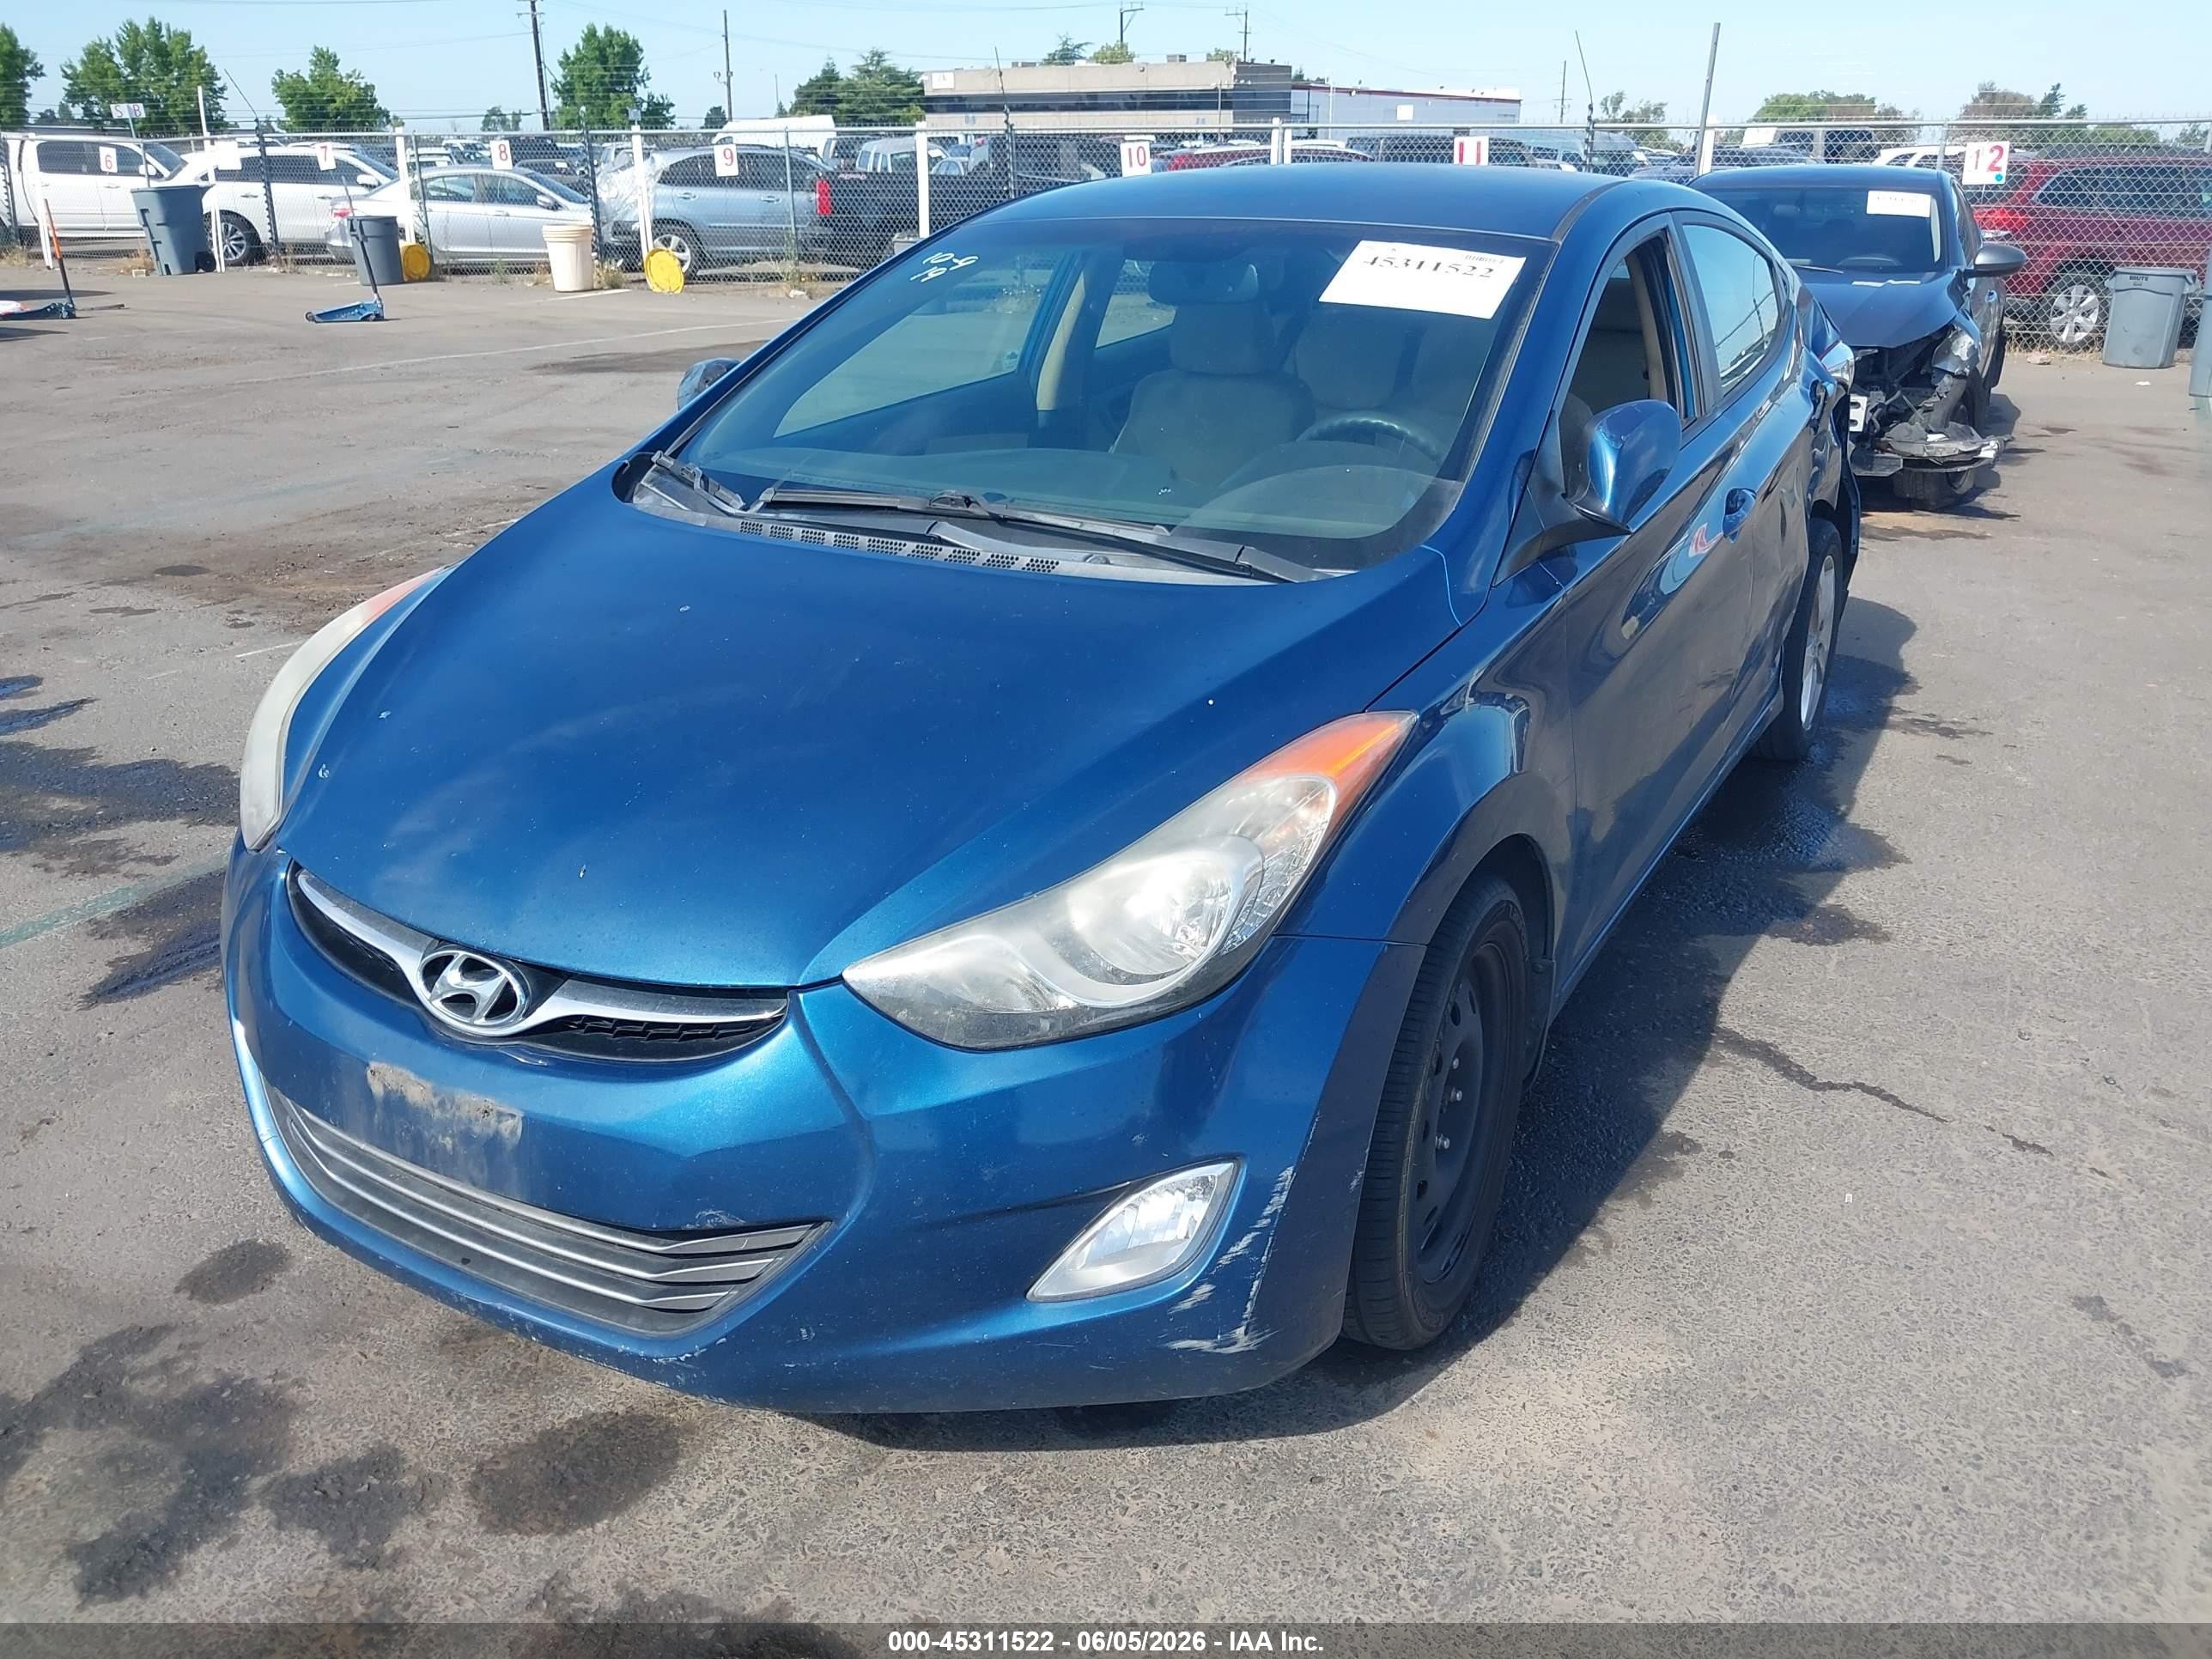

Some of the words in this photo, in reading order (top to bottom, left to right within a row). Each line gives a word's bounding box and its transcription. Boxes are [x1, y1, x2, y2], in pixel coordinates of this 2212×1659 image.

[319, 145, 327, 162] 7
[498, 143, 508, 161] 8
[723, 148, 734, 167] 9
[1127, 145, 1146, 168] 10
[1974, 144, 2004, 172] 12
[105, 154, 112, 170] 6
[1363, 256, 1495, 278] 45311522
